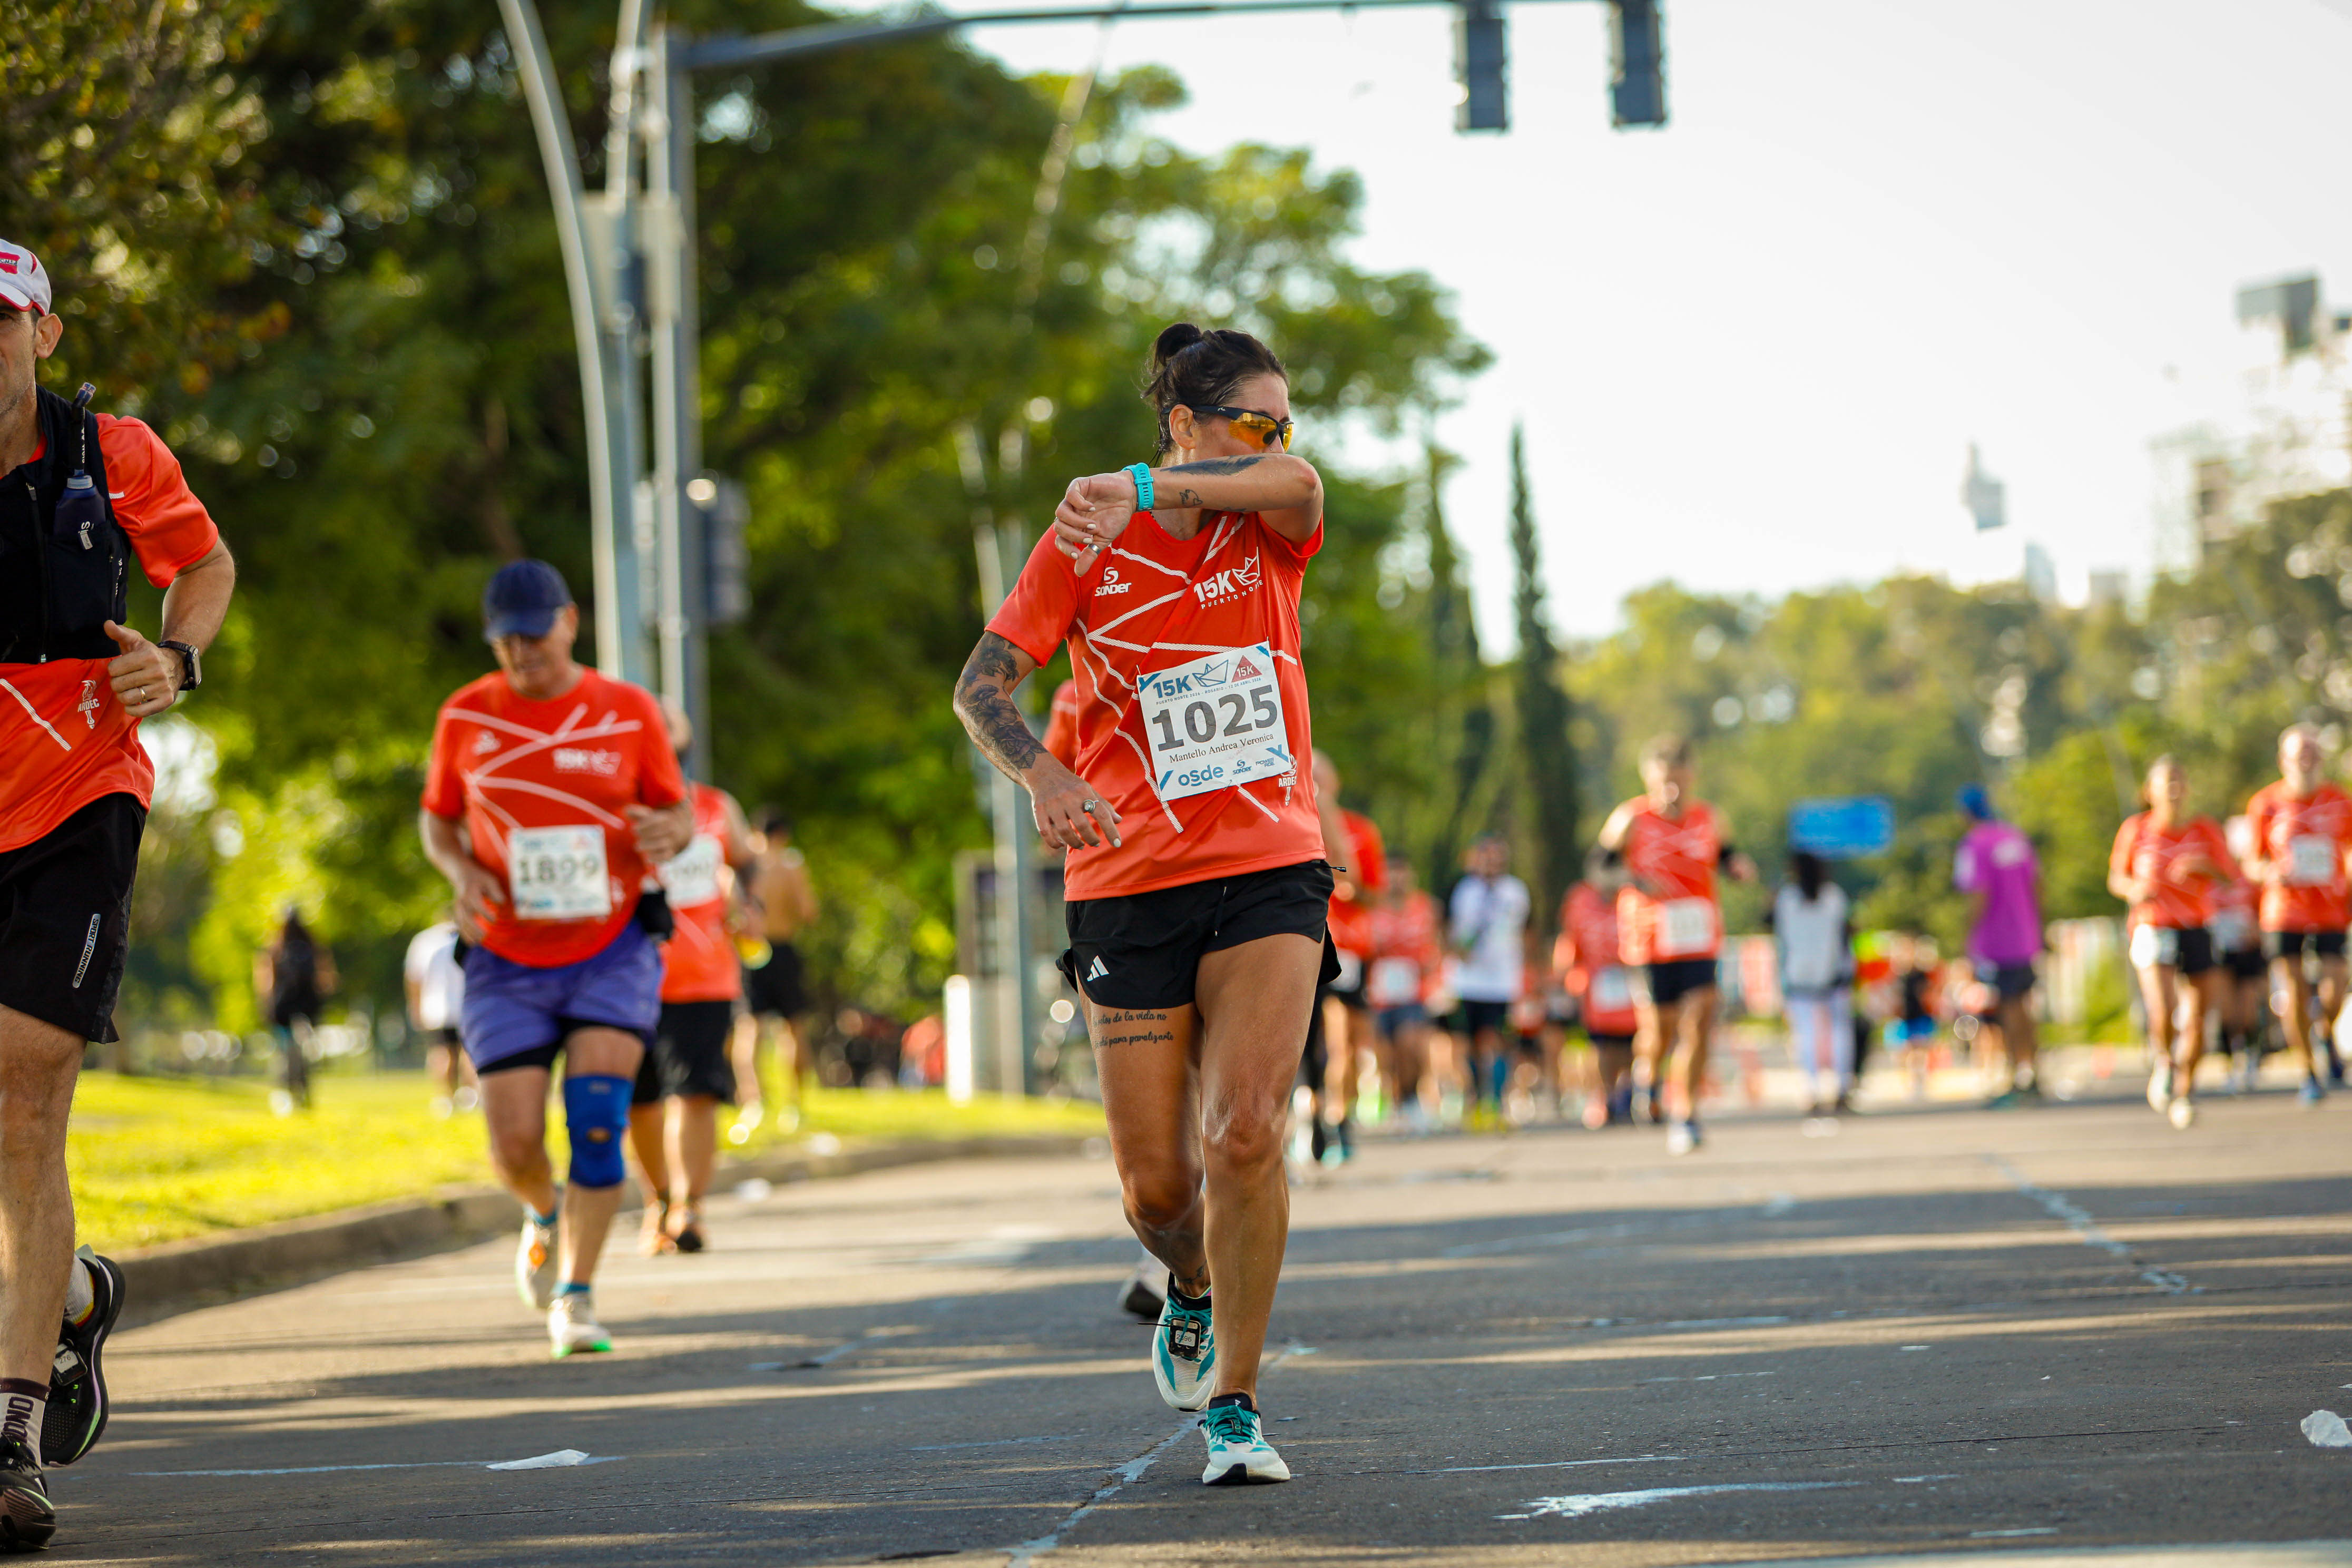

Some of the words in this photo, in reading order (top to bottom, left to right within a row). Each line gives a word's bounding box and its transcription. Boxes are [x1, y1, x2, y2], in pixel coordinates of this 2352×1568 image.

[1193, 570, 1236, 603] 15K
[1201, 594, 1238, 610] PUERTO
[1236, 665, 1255, 678] 15K
[1153, 674, 1193, 699] 15K
[77, 698, 100, 713] ARDEC
[1152, 684, 1278, 752] 1025
[1169, 749, 1206, 763] Mantello
[1209, 742, 1238, 754] Andrea
[1239, 733, 1273, 747] Veronica
[1256, 757, 1274, 766] POWER
[1178, 764, 1223, 787] osde
[87, 918, 99, 943] SPORT
[74, 944, 93, 984] RUNNING
[1113, 1012, 1123, 1023] de
[1124, 1011, 1134, 1021] la
[1136, 1010, 1155, 1021] vida
[1109, 1036, 1128, 1048] para
[1129, 1031, 1174, 1046] paralizarte
[58, 1355, 72, 1364] 276
